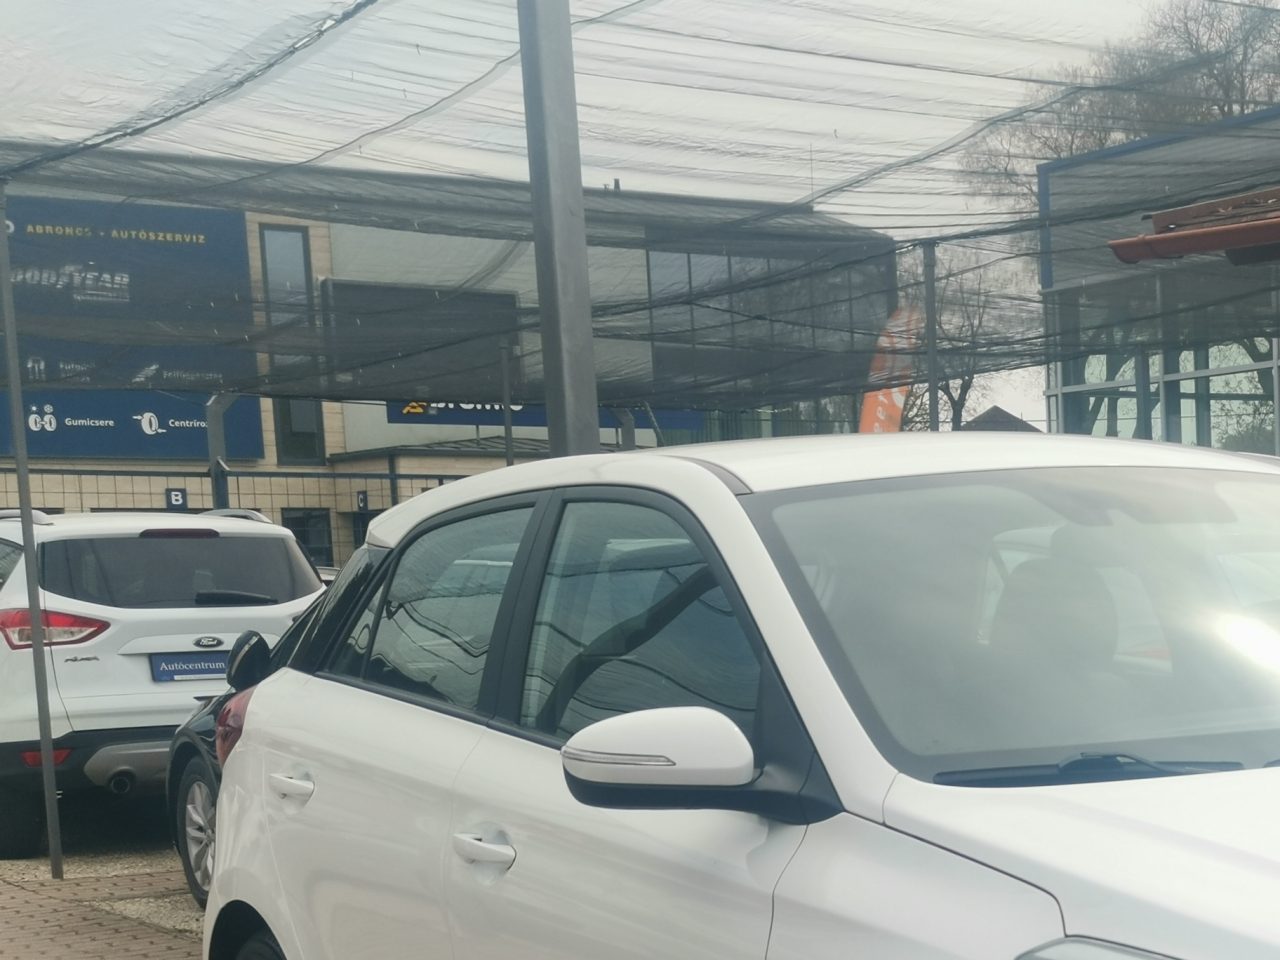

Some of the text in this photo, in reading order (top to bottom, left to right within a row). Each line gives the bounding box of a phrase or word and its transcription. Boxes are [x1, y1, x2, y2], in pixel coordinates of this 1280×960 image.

[64, 417, 115, 428] Gumicsere
[169, 418, 208, 428] Centríro
[171, 491, 183, 505] B
[160, 661, 225, 671] Autócentrum
